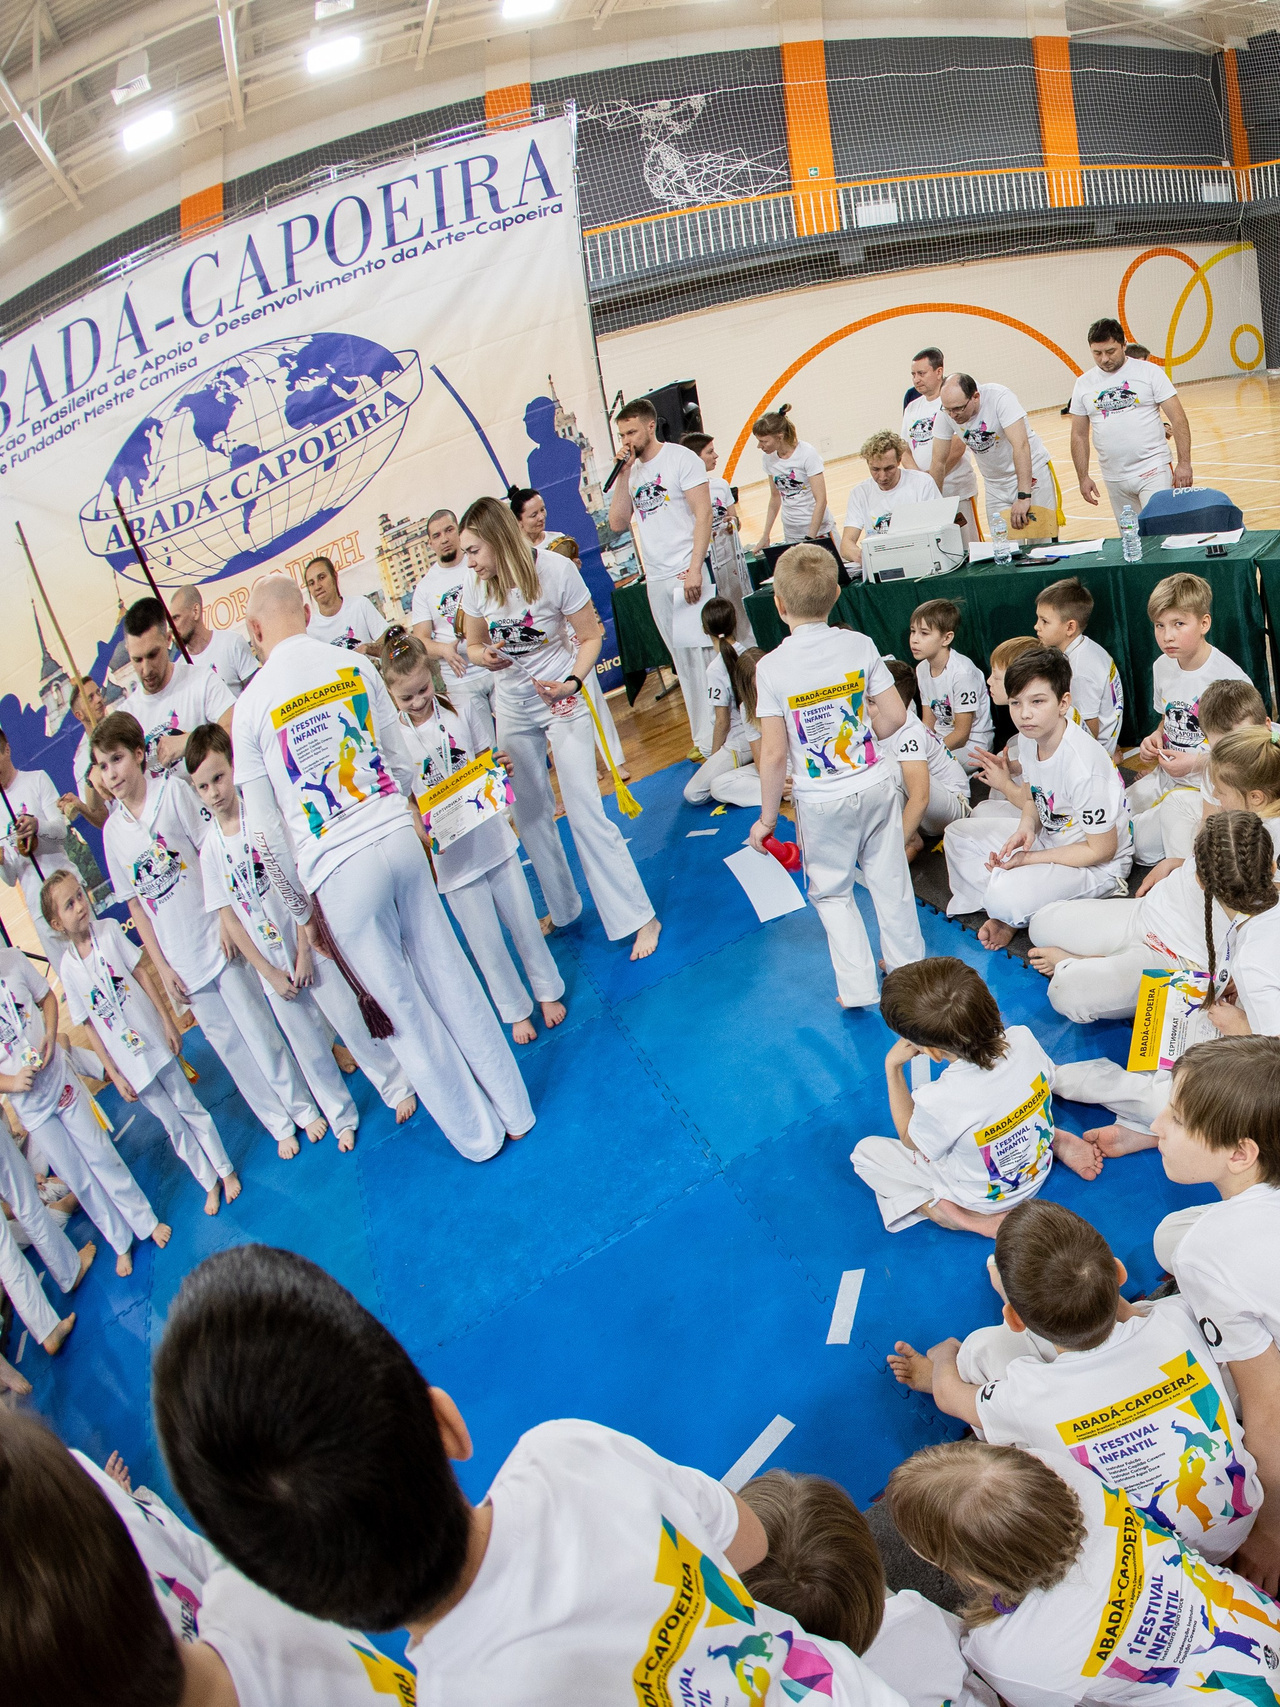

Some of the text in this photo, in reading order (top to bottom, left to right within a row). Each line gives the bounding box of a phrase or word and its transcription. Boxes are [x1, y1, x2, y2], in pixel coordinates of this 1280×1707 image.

[31, 382, 109, 437] Brasileira
[114, 366, 137, 387] de
[140, 340, 194, 373] Apoio
[198, 332, 210, 346] e
[215, 255, 386, 337] Desenvolvimento
[391, 245, 418, 265] da
[421, 201, 563, 256] Arte-Capoeira
[11, 418, 82, 469] Fundador:
[84, 386, 135, 423] Mestre
[139, 356, 198, 391] Camisa
[105, 389, 408, 552] ABADÁ-CAPOEIRA
[280, 680, 357, 716] ABADÁ-CAPOEIRA
[708, 687, 721, 701] 12
[795, 682, 859, 703] ABADÁ-CAPOEIRA
[961, 691, 977, 705] 23
[295, 711, 331, 734] FESTIVAL
[804, 712, 832, 724] INFANTIL
[806, 704, 835, 716] FESTIVAL
[293, 724, 329, 745] INFANTIL
[432, 795, 464, 818] СЕРТИФИКАТ
[1082, 809, 1107, 825] 52
[1139, 988, 1156, 1057] ABADÁ-CAPOEIRA
[1168, 1017, 1179, 1057] СЕРТИФИКАТ
[984, 1088, 1046, 1138] ABADÁ-CAPOEIRA
[996, 1135, 1029, 1157] INFANTIL
[999, 1125, 1031, 1149] FESTIVAL
[1072, 1373, 1196, 1433] ABADÁ-CAPOEIRA
[1099, 1423, 1160, 1452] FESTIVAL
[1098, 1438, 1158, 1464] INFANTIL
[1133, 1574, 1164, 1646] FESTIVAL
[1145, 1590, 1180, 1661] INFANTIL
